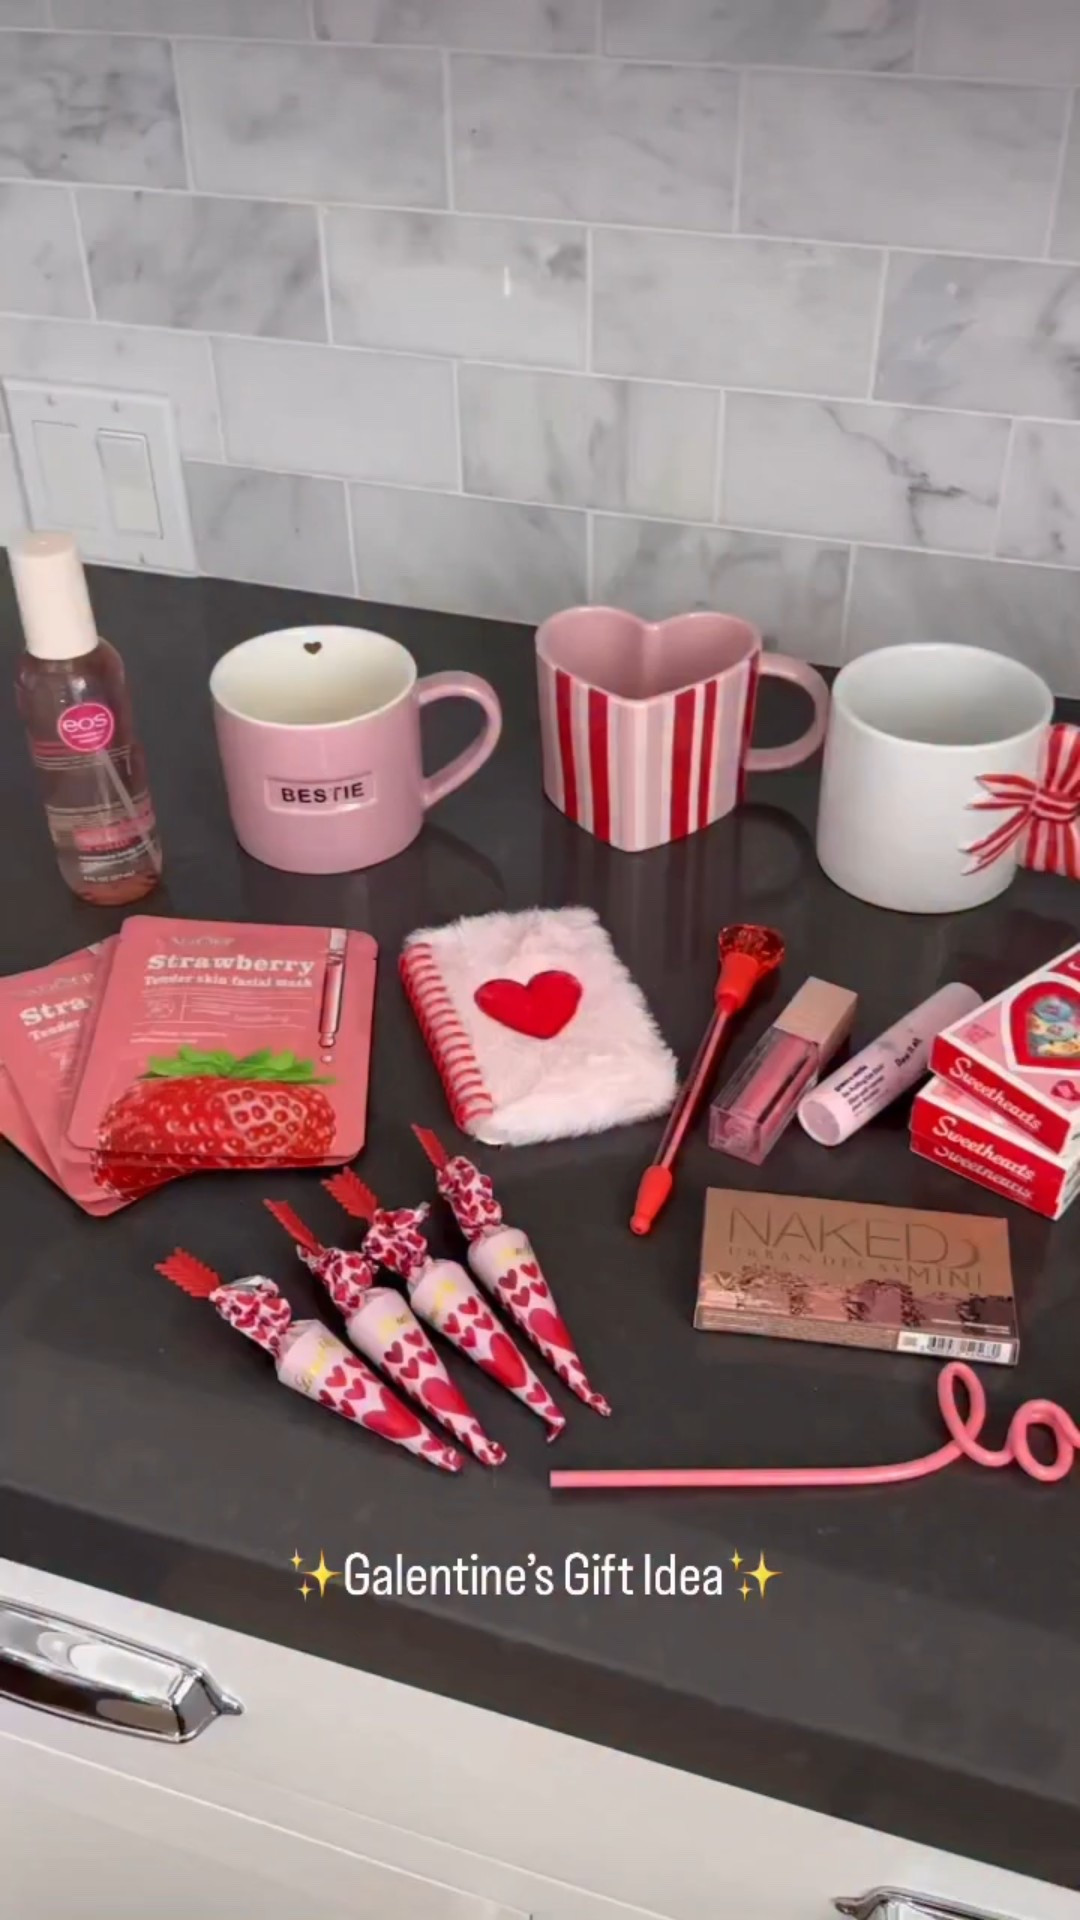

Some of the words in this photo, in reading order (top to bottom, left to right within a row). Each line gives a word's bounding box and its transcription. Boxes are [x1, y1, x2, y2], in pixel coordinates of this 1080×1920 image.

[63, 713, 108, 733] eos
[281, 782, 365, 803] BESTIE
[147, 954, 316, 976] Strawberry
[144, 974, 192, 986] Tender
[196, 974, 228, 985] skin
[231, 976, 271, 986] facial
[949, 1056, 1042, 1132] Sweethearts
[932, 1115, 1036, 1182] Sweethearts
[907, 1265, 983, 1288] MINI
